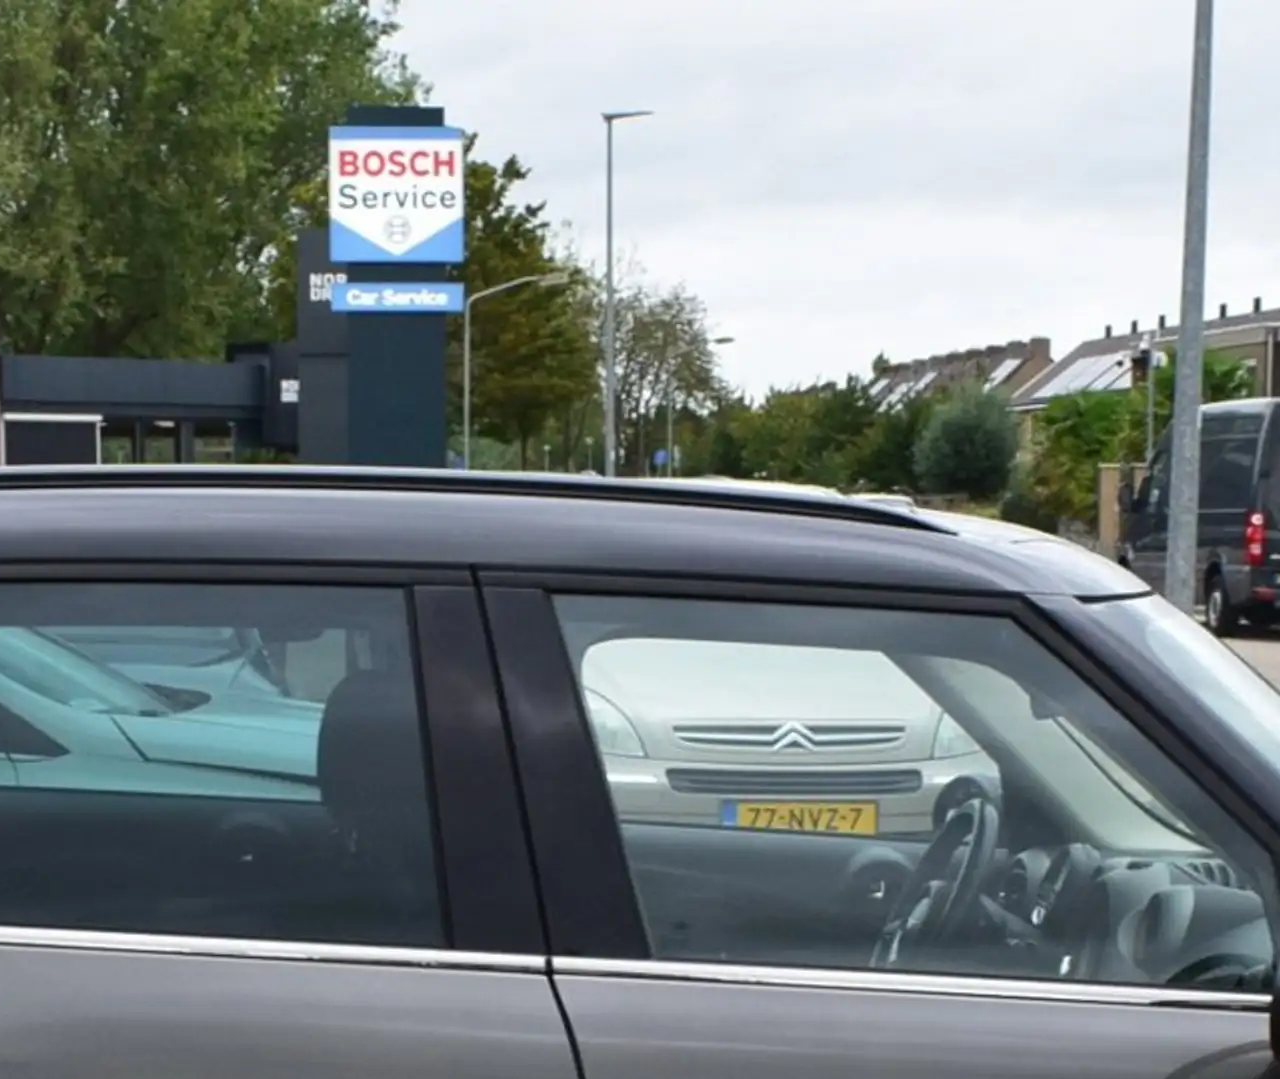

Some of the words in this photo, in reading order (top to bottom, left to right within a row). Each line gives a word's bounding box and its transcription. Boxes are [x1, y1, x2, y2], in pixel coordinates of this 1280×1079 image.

[339, 150, 455, 177] BOSCH
[338, 184, 456, 209] Service
[346, 288, 379, 306] Car
[381, 288, 448, 306] Service
[747, 807, 864, 831] 77-NVZ-7
